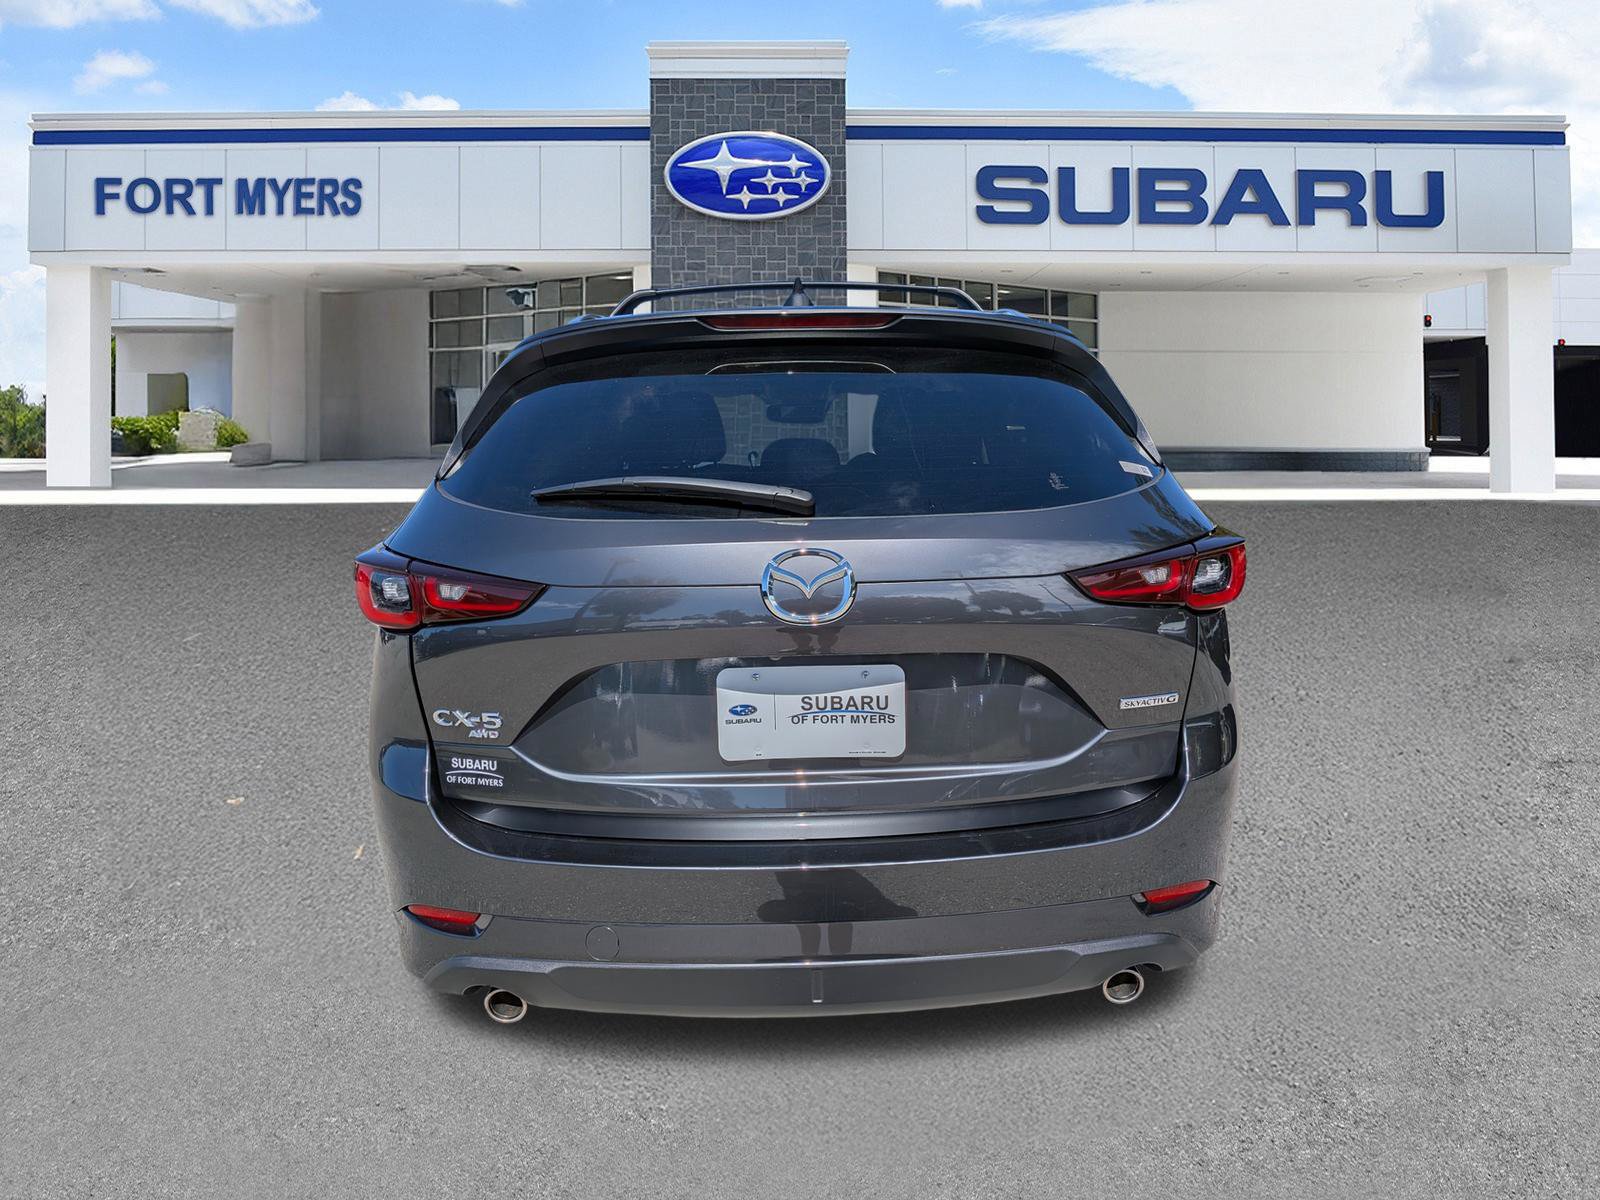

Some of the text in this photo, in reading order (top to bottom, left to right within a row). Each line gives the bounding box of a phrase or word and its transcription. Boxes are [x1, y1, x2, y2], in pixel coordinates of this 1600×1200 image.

[94, 177, 363, 217] FORT MYERS
[975, 165, 1445, 228] SUBARU
[800, 695, 889, 711] SUBARU
[432, 709, 503, 729] CX-5
[725, 717, 762, 725] SUBARU
[790, 714, 896, 725] OF FORT MYERS
[468, 729, 499, 739] AWD
[451, 757, 498, 771] SUBARU
[446, 775, 504, 787] OF FORT MYERS
